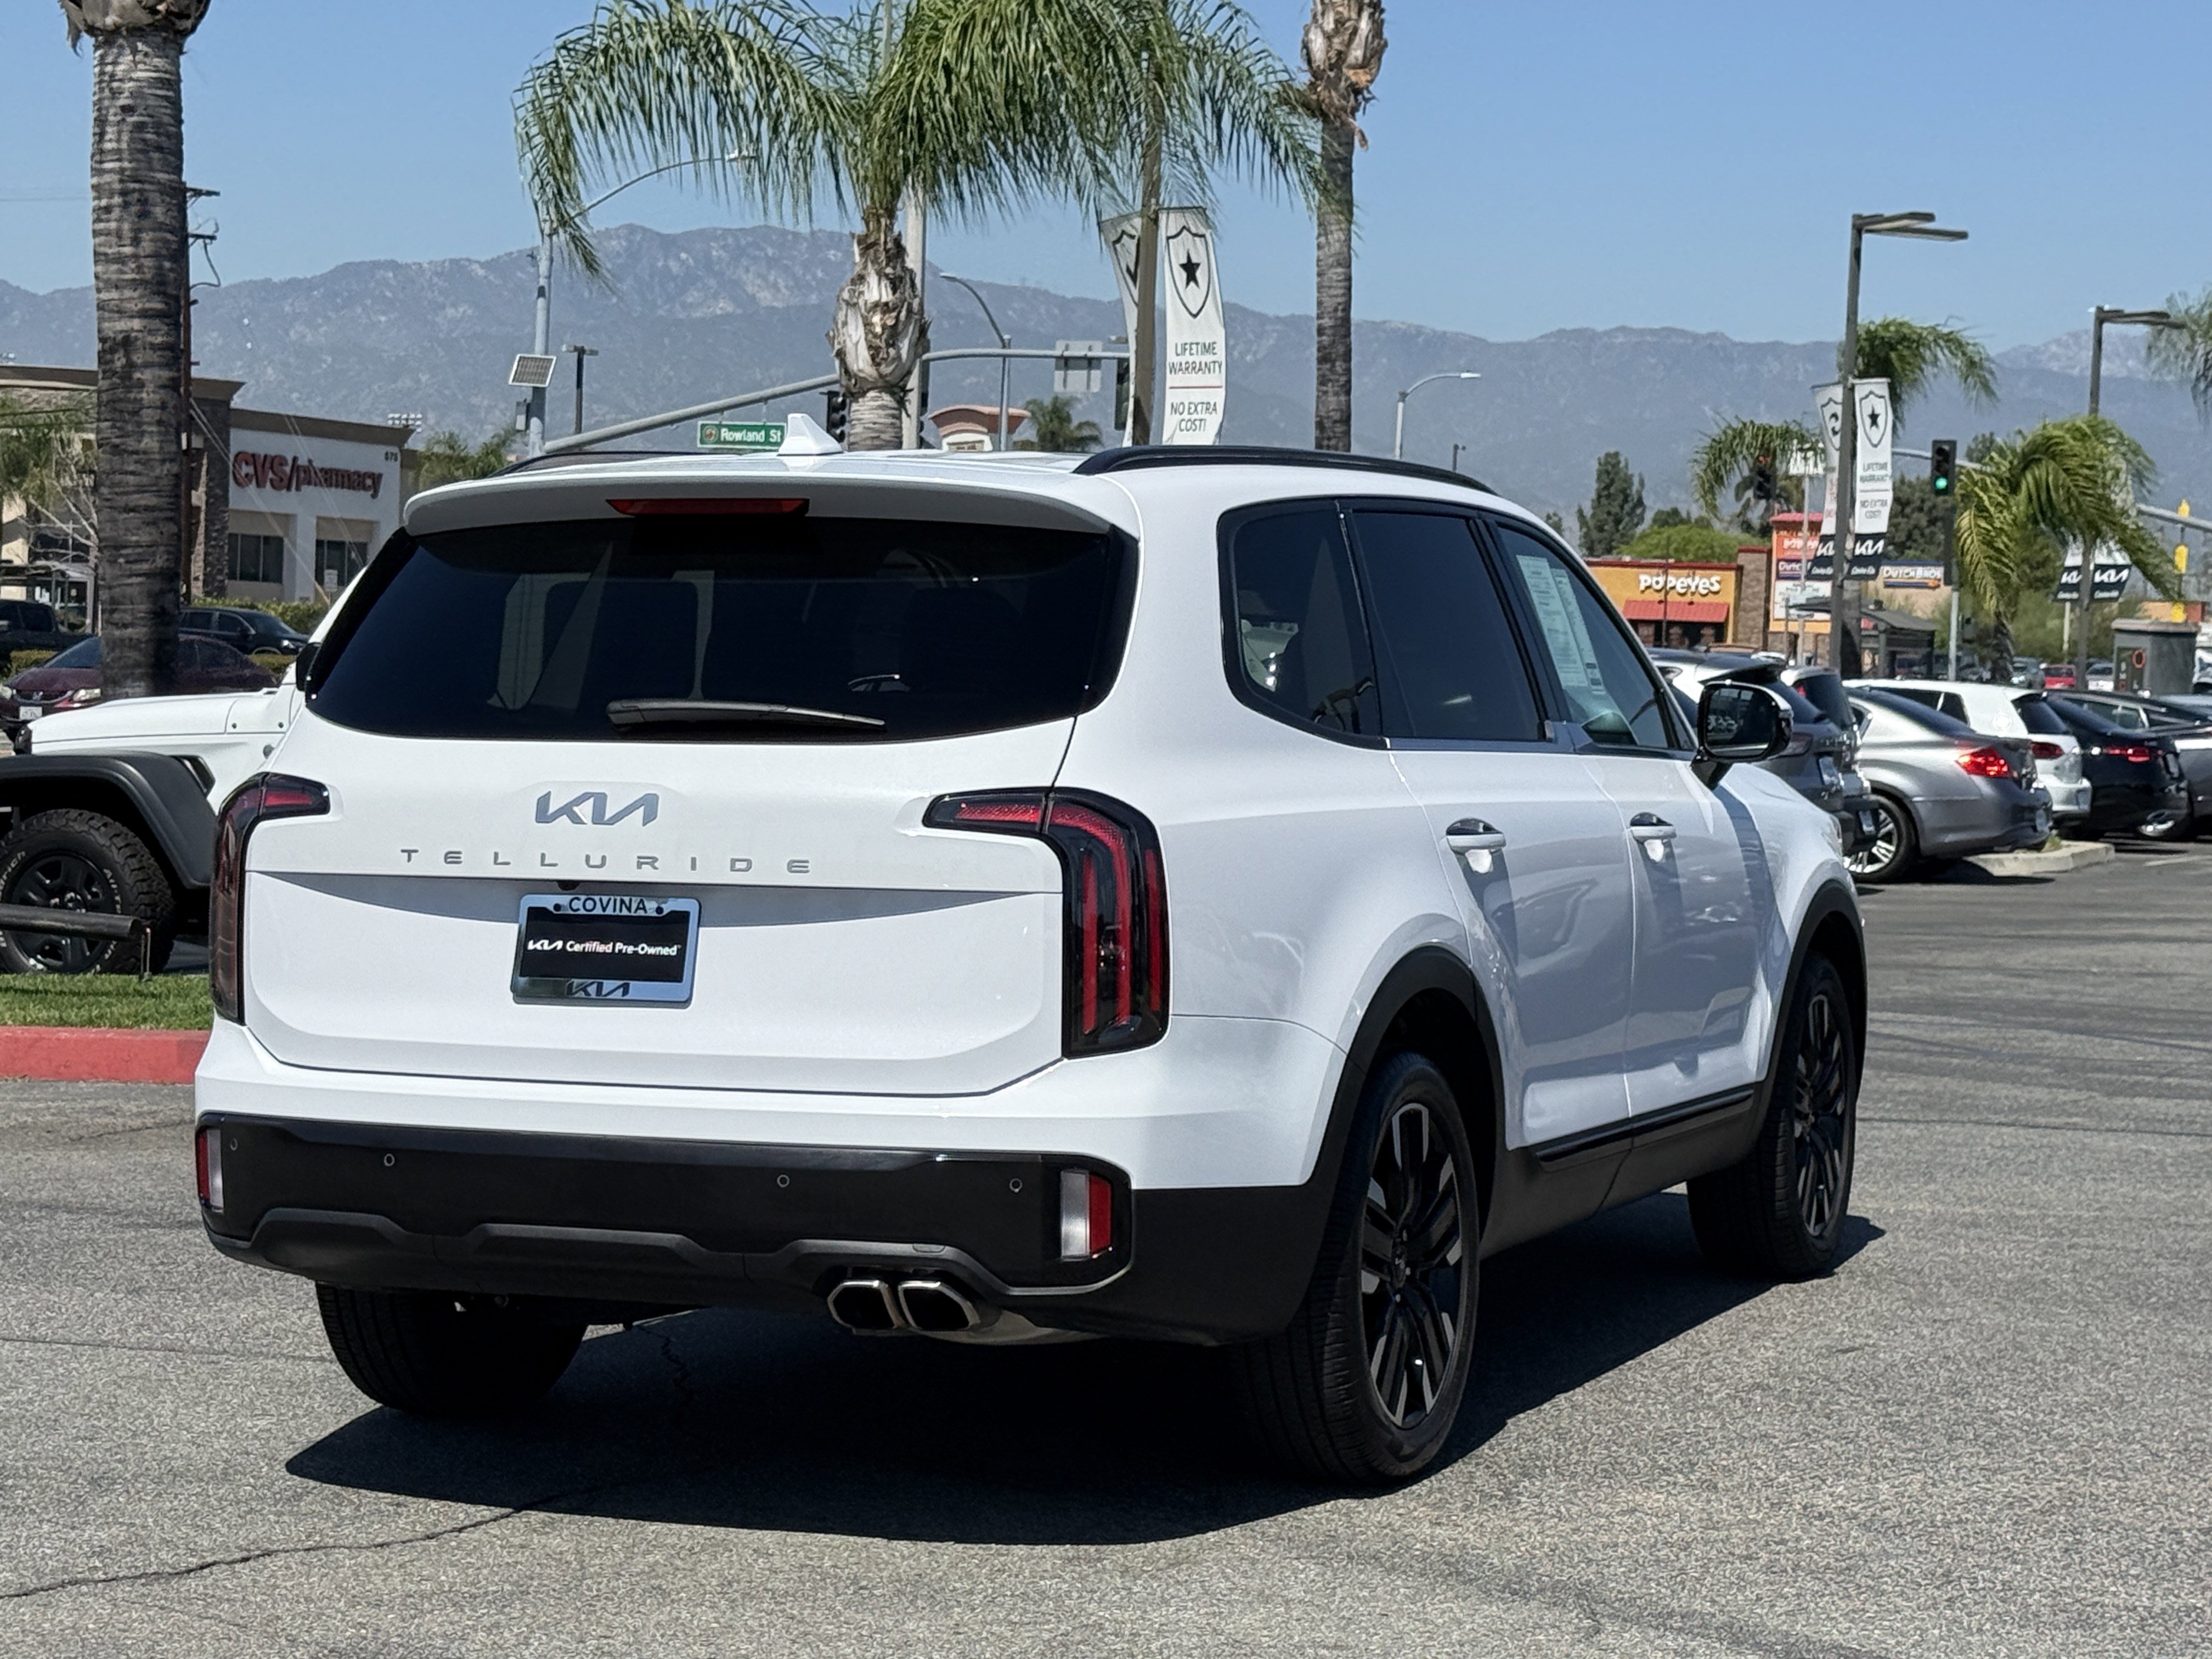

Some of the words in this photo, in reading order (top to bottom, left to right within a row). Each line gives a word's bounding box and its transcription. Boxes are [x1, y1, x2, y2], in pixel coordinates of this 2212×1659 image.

[1175, 341, 1217, 357] LIFETIME
[1169, 360, 1223, 375] WARRANTY
[1170, 402, 1185, 415] NO
[1187, 402, 1217, 415] EXTRA
[1179, 418, 1206, 432] COST!
[720, 428, 765, 442] Rowland
[769, 430, 781, 443] St
[232, 451, 383, 499] CVS/pharmacy
[535, 791, 659, 827] KIA
[400, 849, 810, 873] TELLURIDE
[568, 896, 648, 915] COVINA
[527, 939, 563, 950] KIA
[566, 941, 613, 953] Certified
[615, 943, 678, 956] Pre-Owned
[566, 980, 630, 997] KIA
